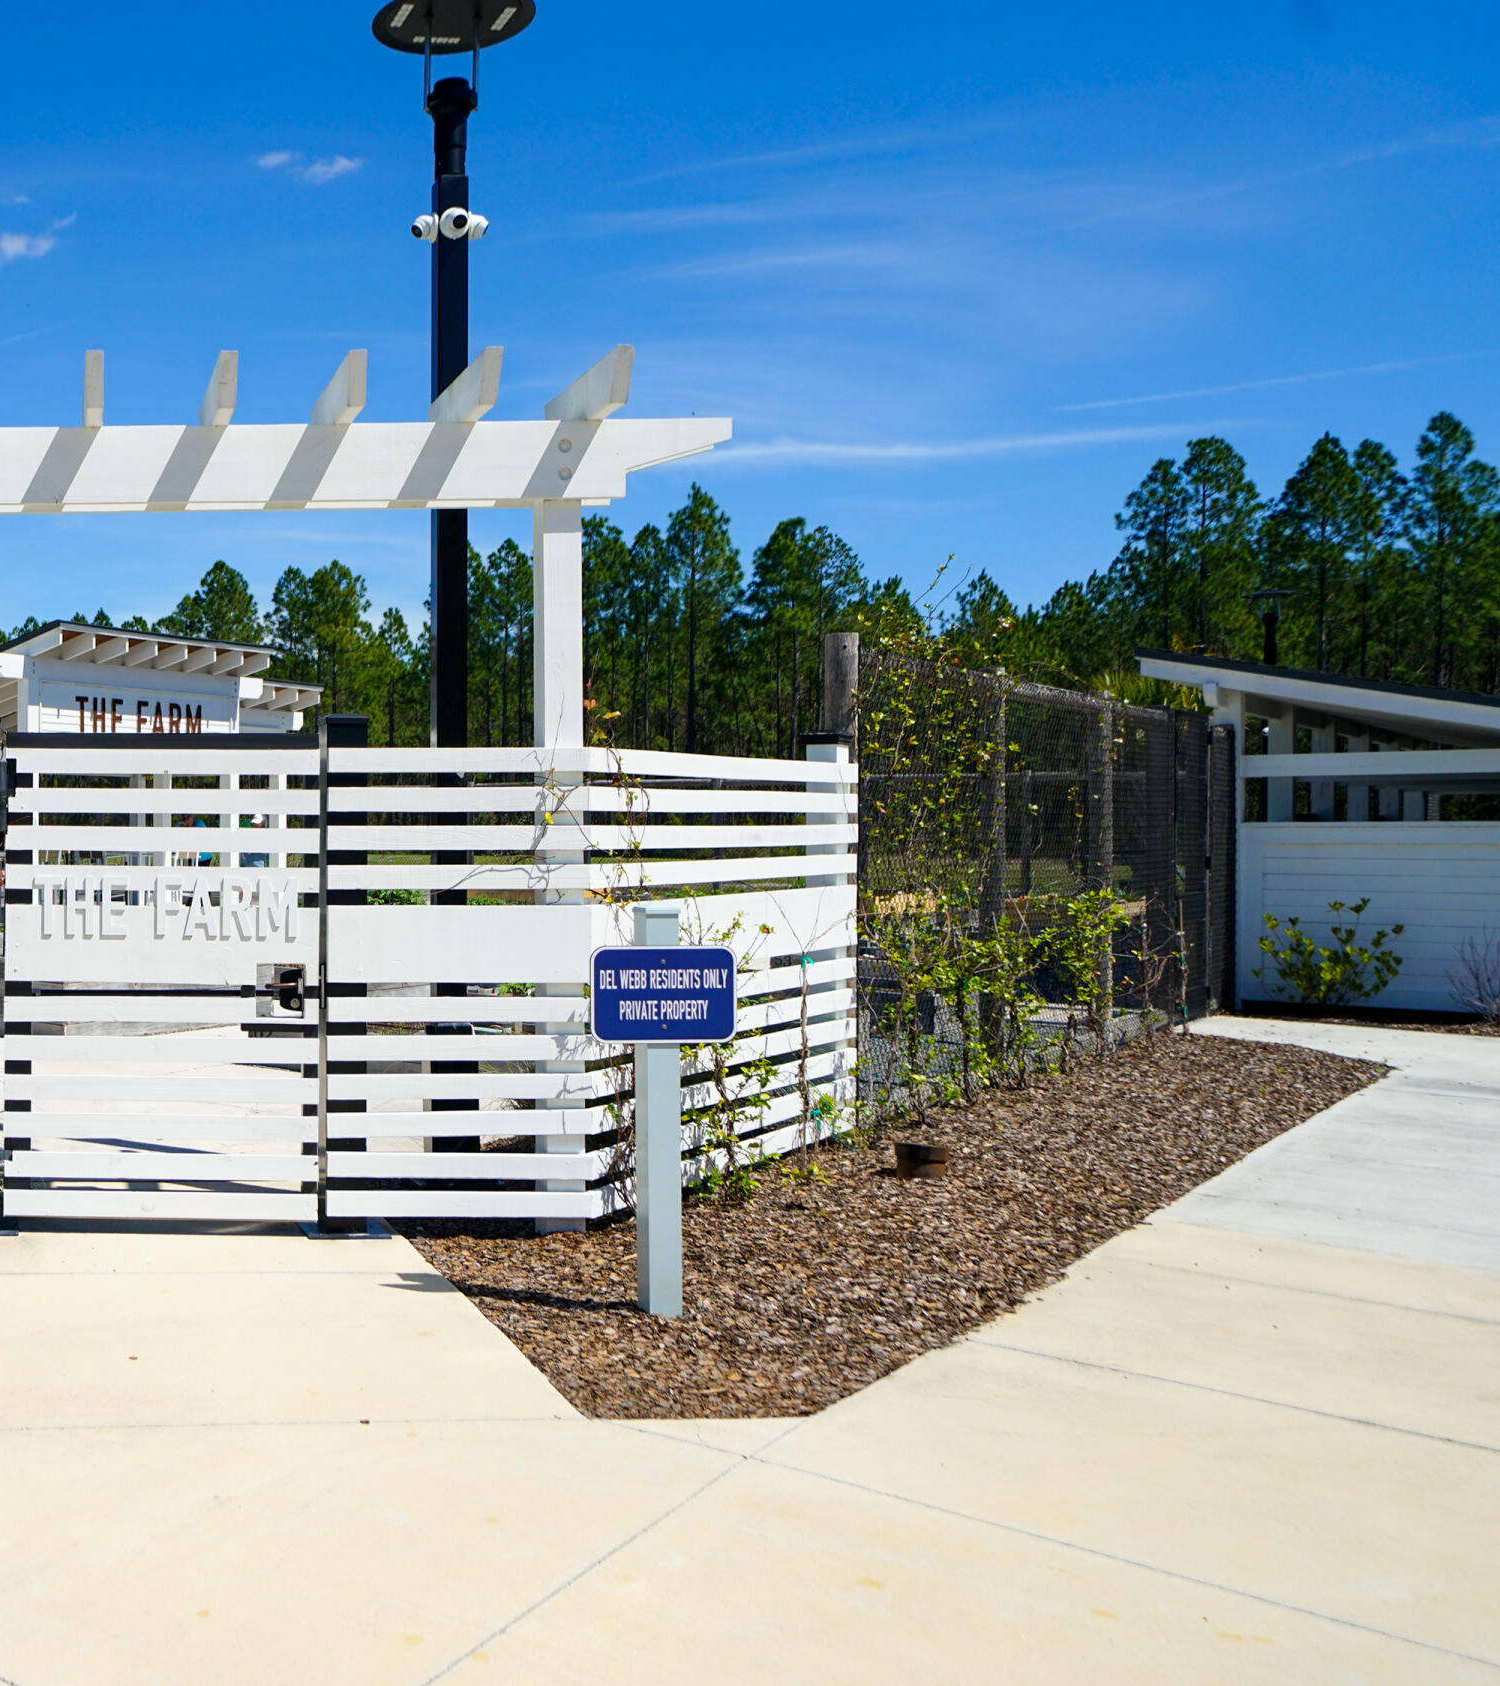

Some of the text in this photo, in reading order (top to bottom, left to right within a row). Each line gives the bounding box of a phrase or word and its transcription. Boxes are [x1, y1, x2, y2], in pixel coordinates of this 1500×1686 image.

[75, 696, 202, 734] THE FARM
[33, 876, 299, 942] THE FARM
[600, 968, 728, 990] DEL WEBB RESIDENTS ONLY
[619, 1000, 709, 1021] PRIVATE PROPERTY
